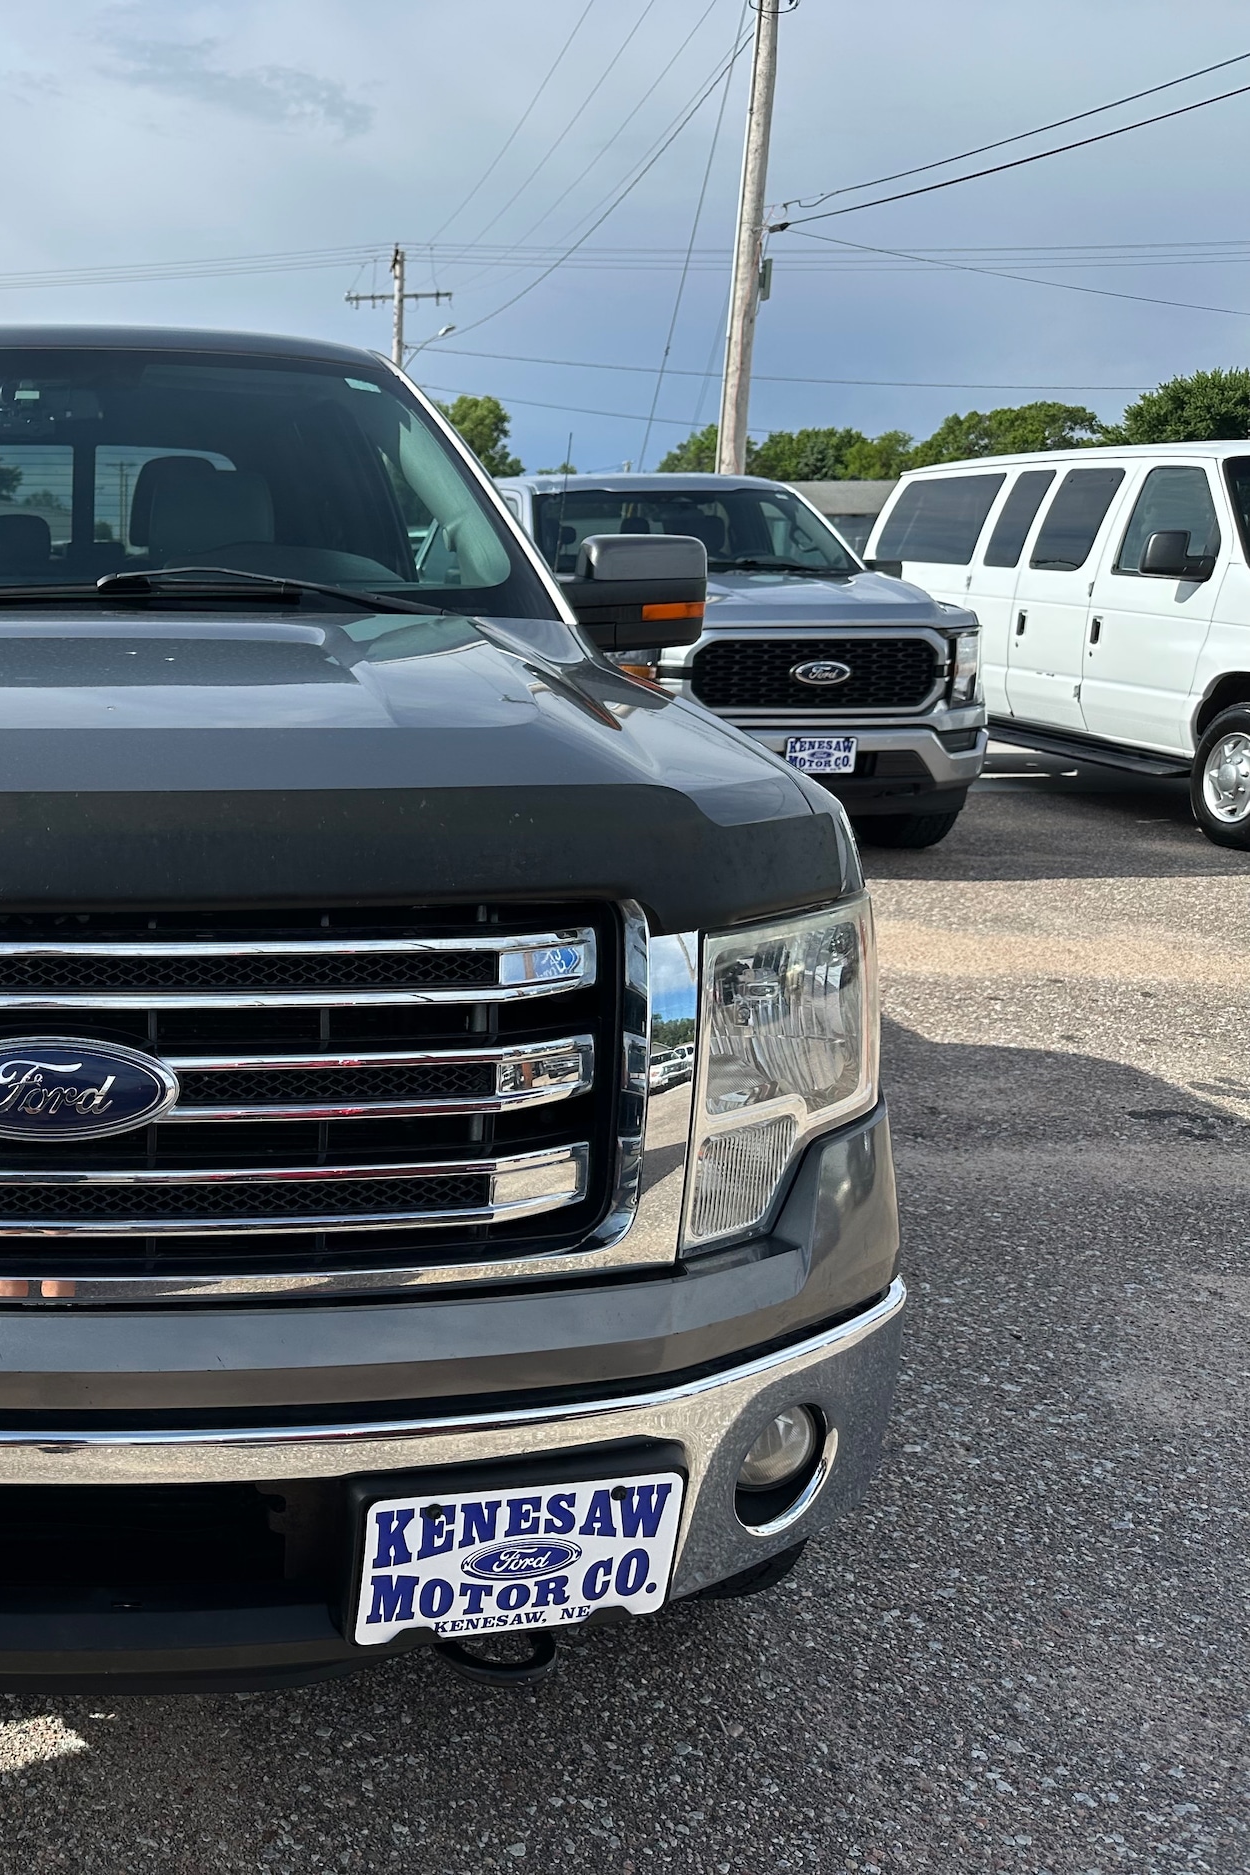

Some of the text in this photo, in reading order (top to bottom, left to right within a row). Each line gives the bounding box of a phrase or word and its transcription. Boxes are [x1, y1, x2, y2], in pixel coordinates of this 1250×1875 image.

[808, 665, 839, 679] Ford
[789, 740, 854, 753] KENESAW
[788, 755, 852, 768] MOTOR CO.
[372, 1483, 672, 1569] KENESAW
[492, 1547, 552, 1572] Ford
[366, 1548, 657, 1624] MOTOR CO.
[434, 1611, 547, 1633] KENESAW,
